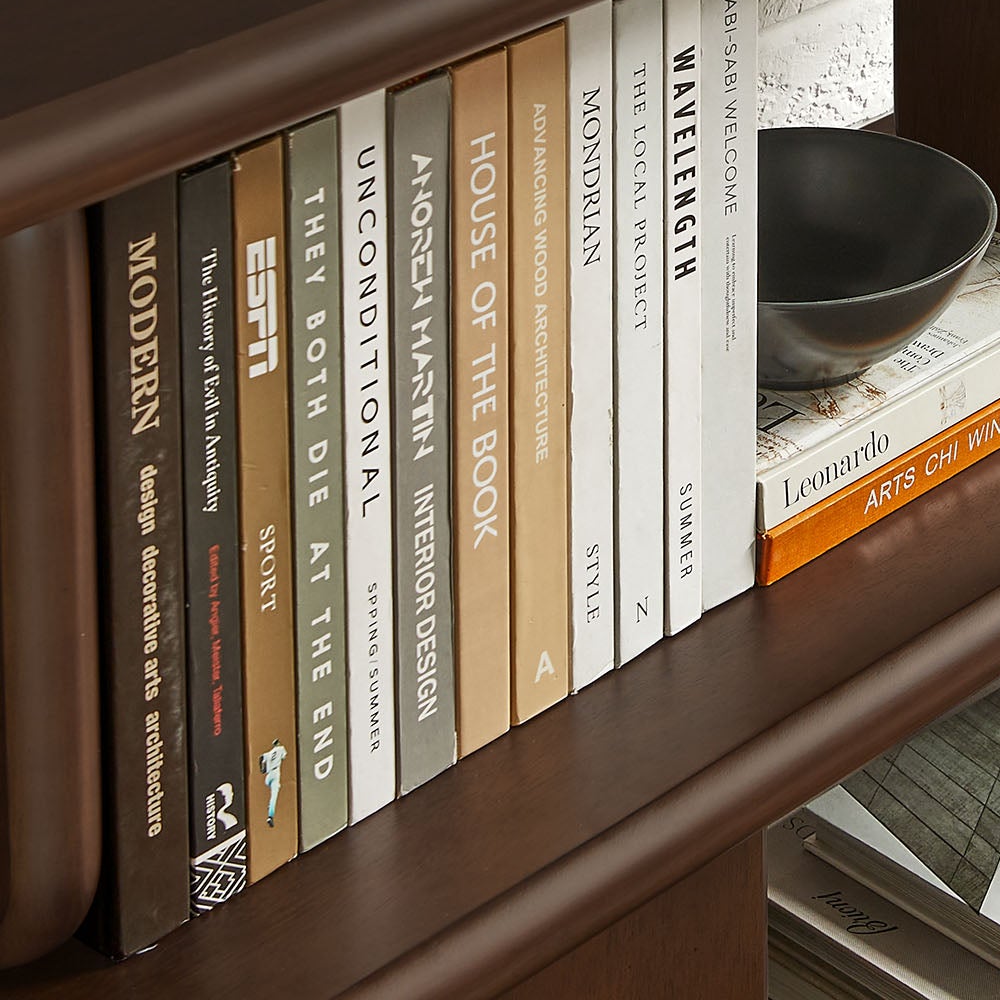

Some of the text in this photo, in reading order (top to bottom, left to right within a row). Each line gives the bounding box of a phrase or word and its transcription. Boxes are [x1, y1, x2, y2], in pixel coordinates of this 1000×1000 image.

[582, 87, 600, 267] MONDRIAN
[633, 62, 647, 331] THE LOCAL PROJECT
[673, 44, 697, 280] WAVELENGTH
[724, 99, 738, 217] WELCOME
[128, 232, 160, 435] MODERN
[246, 236, 278, 378] ESPN
[358, 145, 380, 518] UNCONDITIONAL
[470, 132, 498, 550] HOUSE OF THE BOOK
[532, 102, 549, 464] ADVANCING WOOD ARCHITECTURE
[199, 247, 222, 513] The History of Evil in Antiquity
[411, 316, 434, 461] MARTIN
[304, 187, 334, 780] THEY BOTH DIE AT THE END
[680, 482, 693, 579] SUMMER
[783, 430, 890, 510] Leonardo
[863, 466, 916, 515] ARTS
[924, 440, 959, 477] CHI
[259, 523, 276, 612] SPORT
[414, 483, 438, 722] INTERIOR DESIGN
[586, 544, 600, 623] STYLE
[137, 463, 164, 838] design decorative arts architecture
[534, 650, 555, 683] A
[205, 793, 217, 840] HISTORY
[811, 891, 899, 935] Brioni
